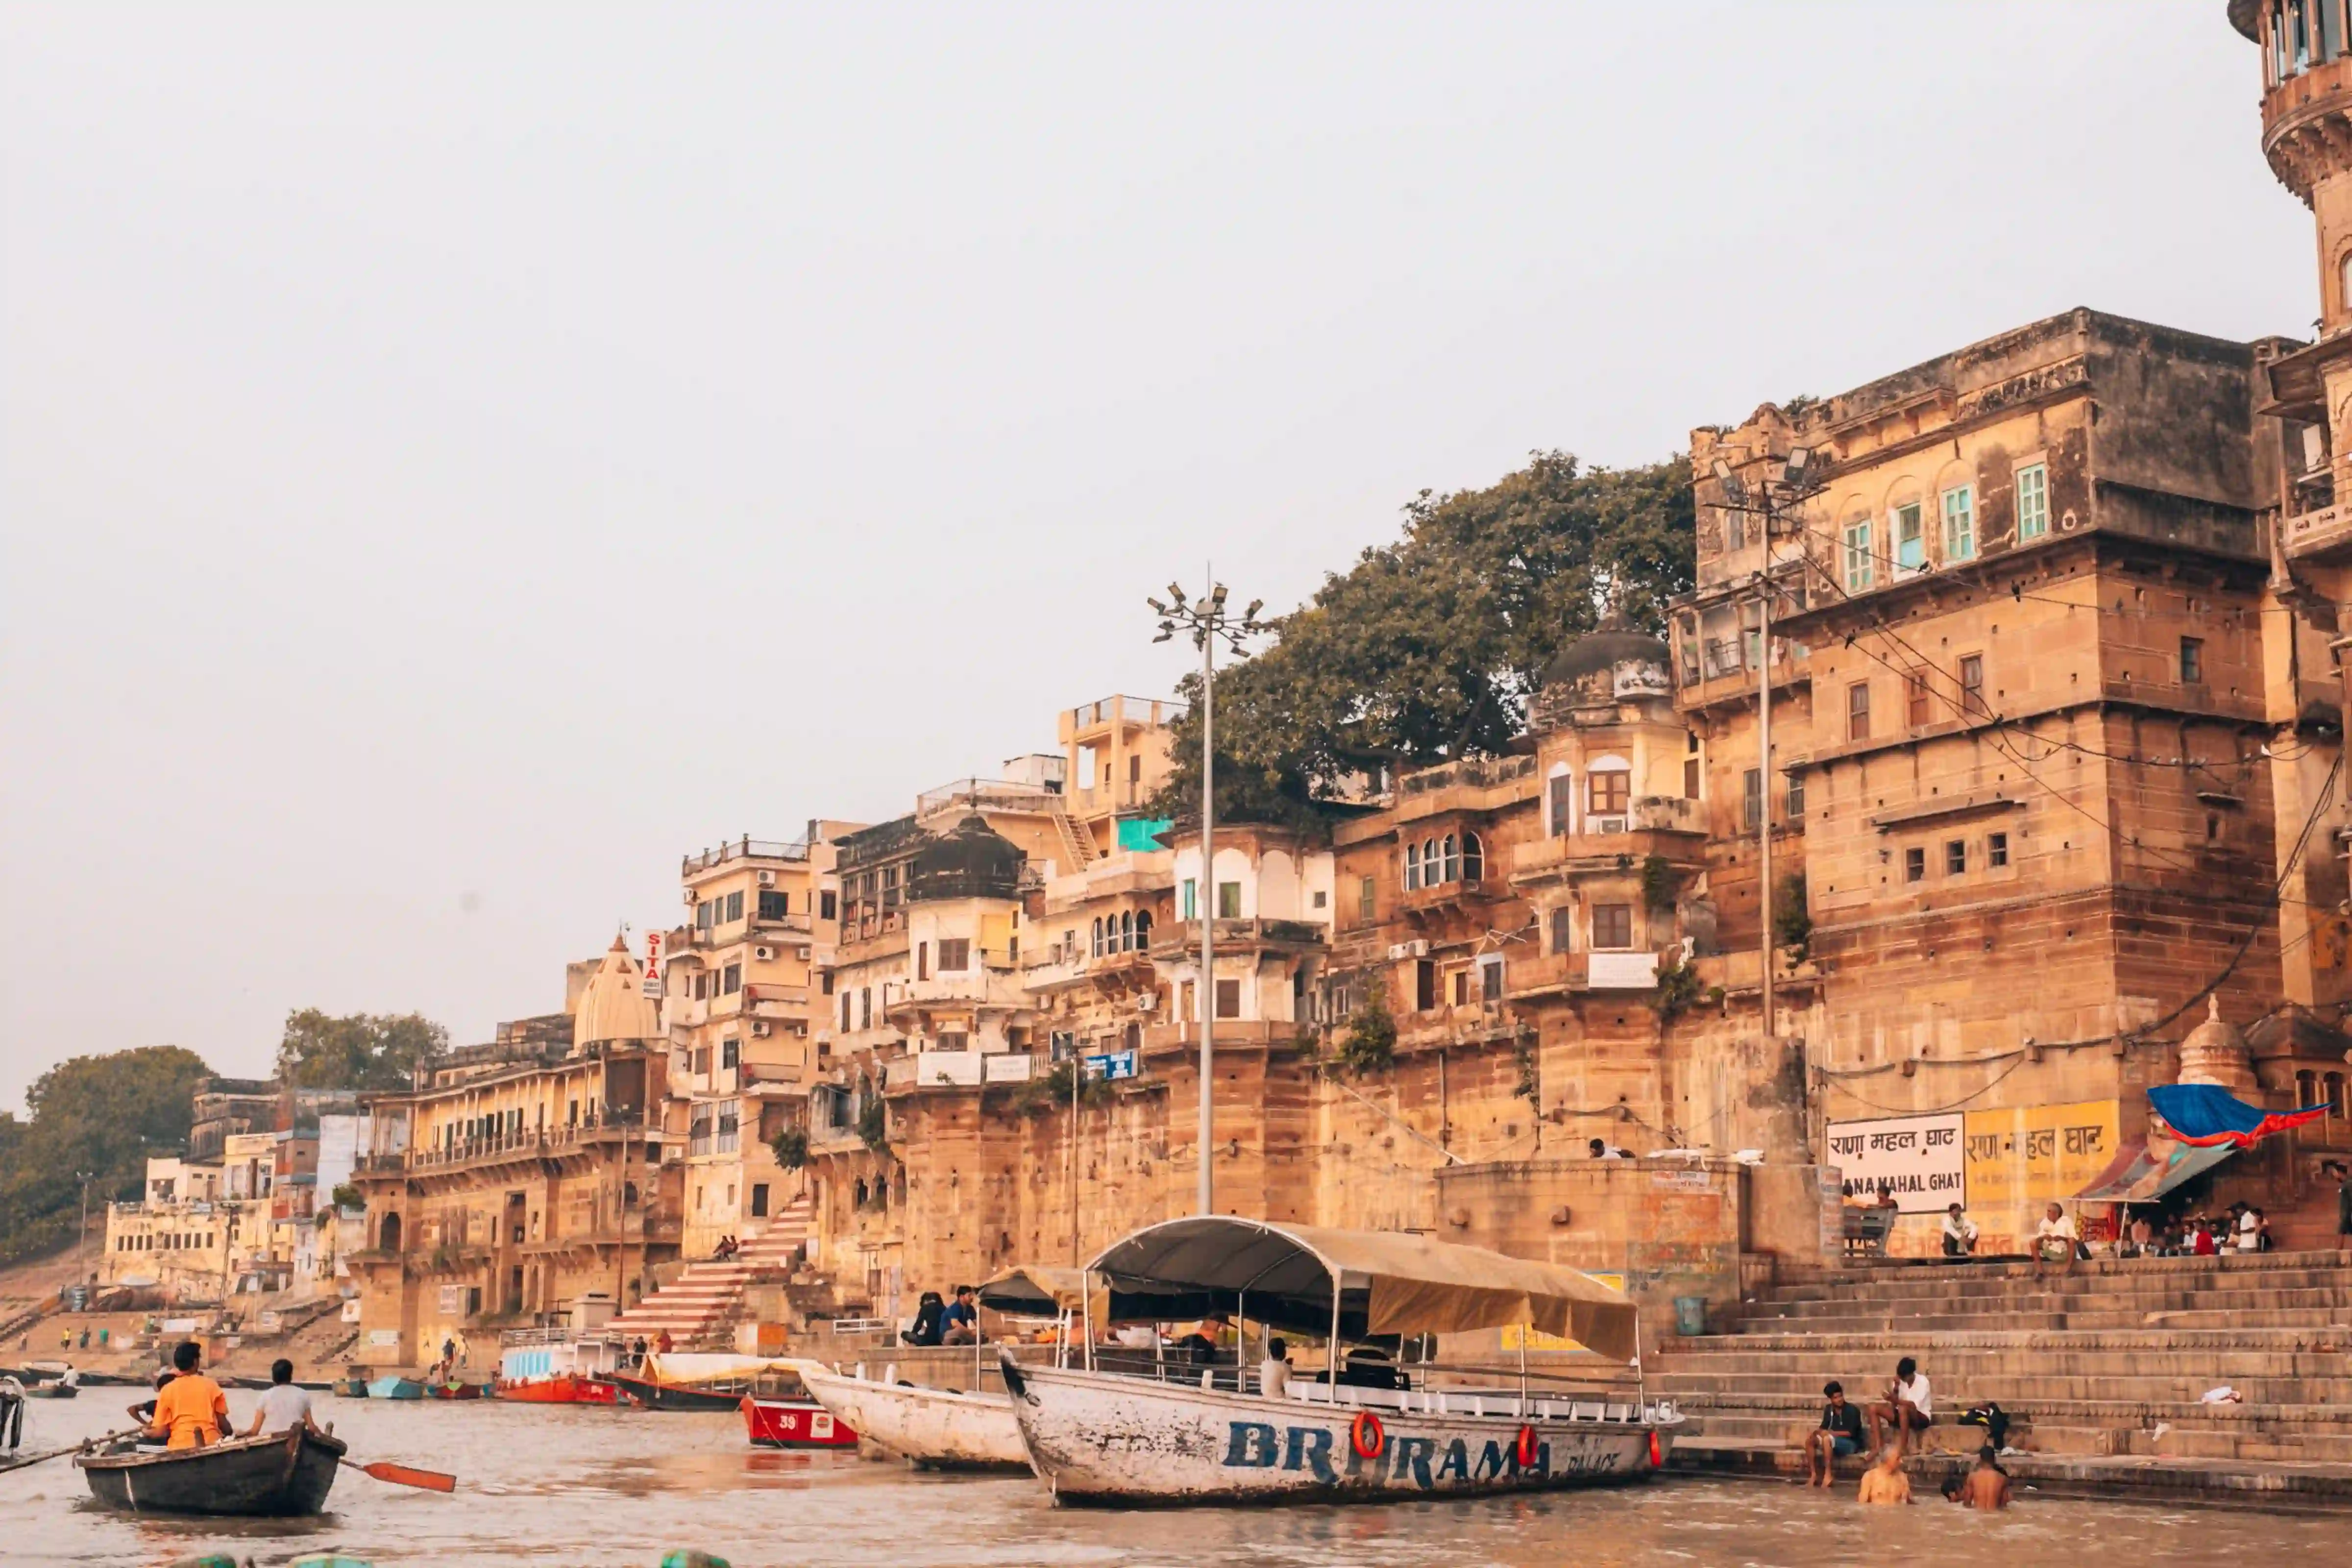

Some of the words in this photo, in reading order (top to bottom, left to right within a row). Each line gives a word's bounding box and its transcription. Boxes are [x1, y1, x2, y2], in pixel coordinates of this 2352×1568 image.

[645, 934, 660, 979] SITA
[1830, 1134, 1865, 1155] राणा
[1870, 1131, 1918, 1152] महल
[1926, 1128, 1957, 1147] घाट
[1929, 1172, 1961, 1191] GHAT
[779, 1415, 796, 1430] 39
